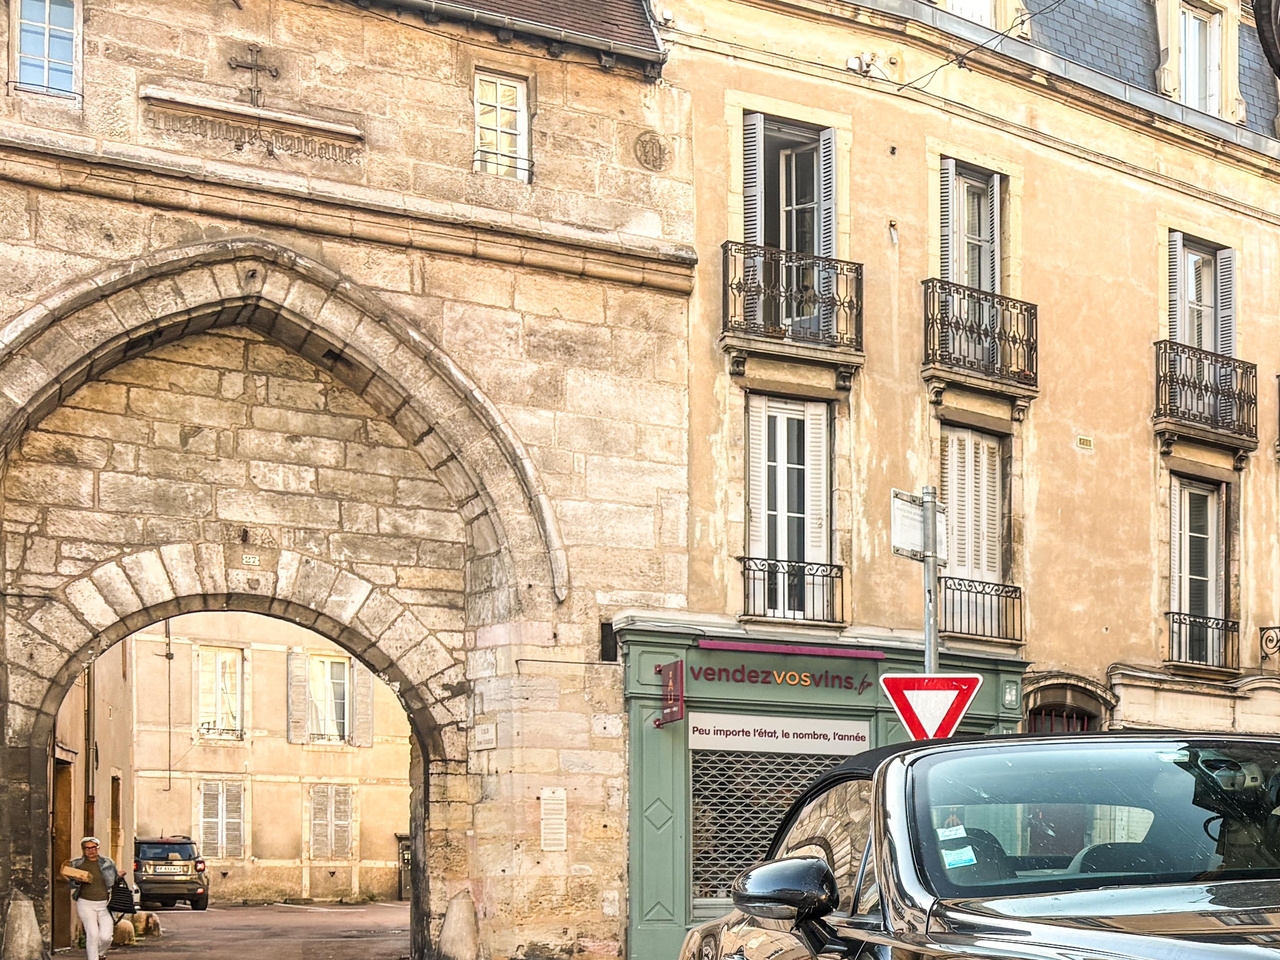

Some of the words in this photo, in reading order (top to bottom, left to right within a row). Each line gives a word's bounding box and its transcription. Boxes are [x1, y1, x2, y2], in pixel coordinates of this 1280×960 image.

[692, 726, 710, 736] Peu
[713, 726, 751, 739] importe
[753, 727, 779, 740] l'état,
[781, 729, 791, 739] le
[792, 730, 831, 742] nombre,
[833, 732, 867, 742] l'année
